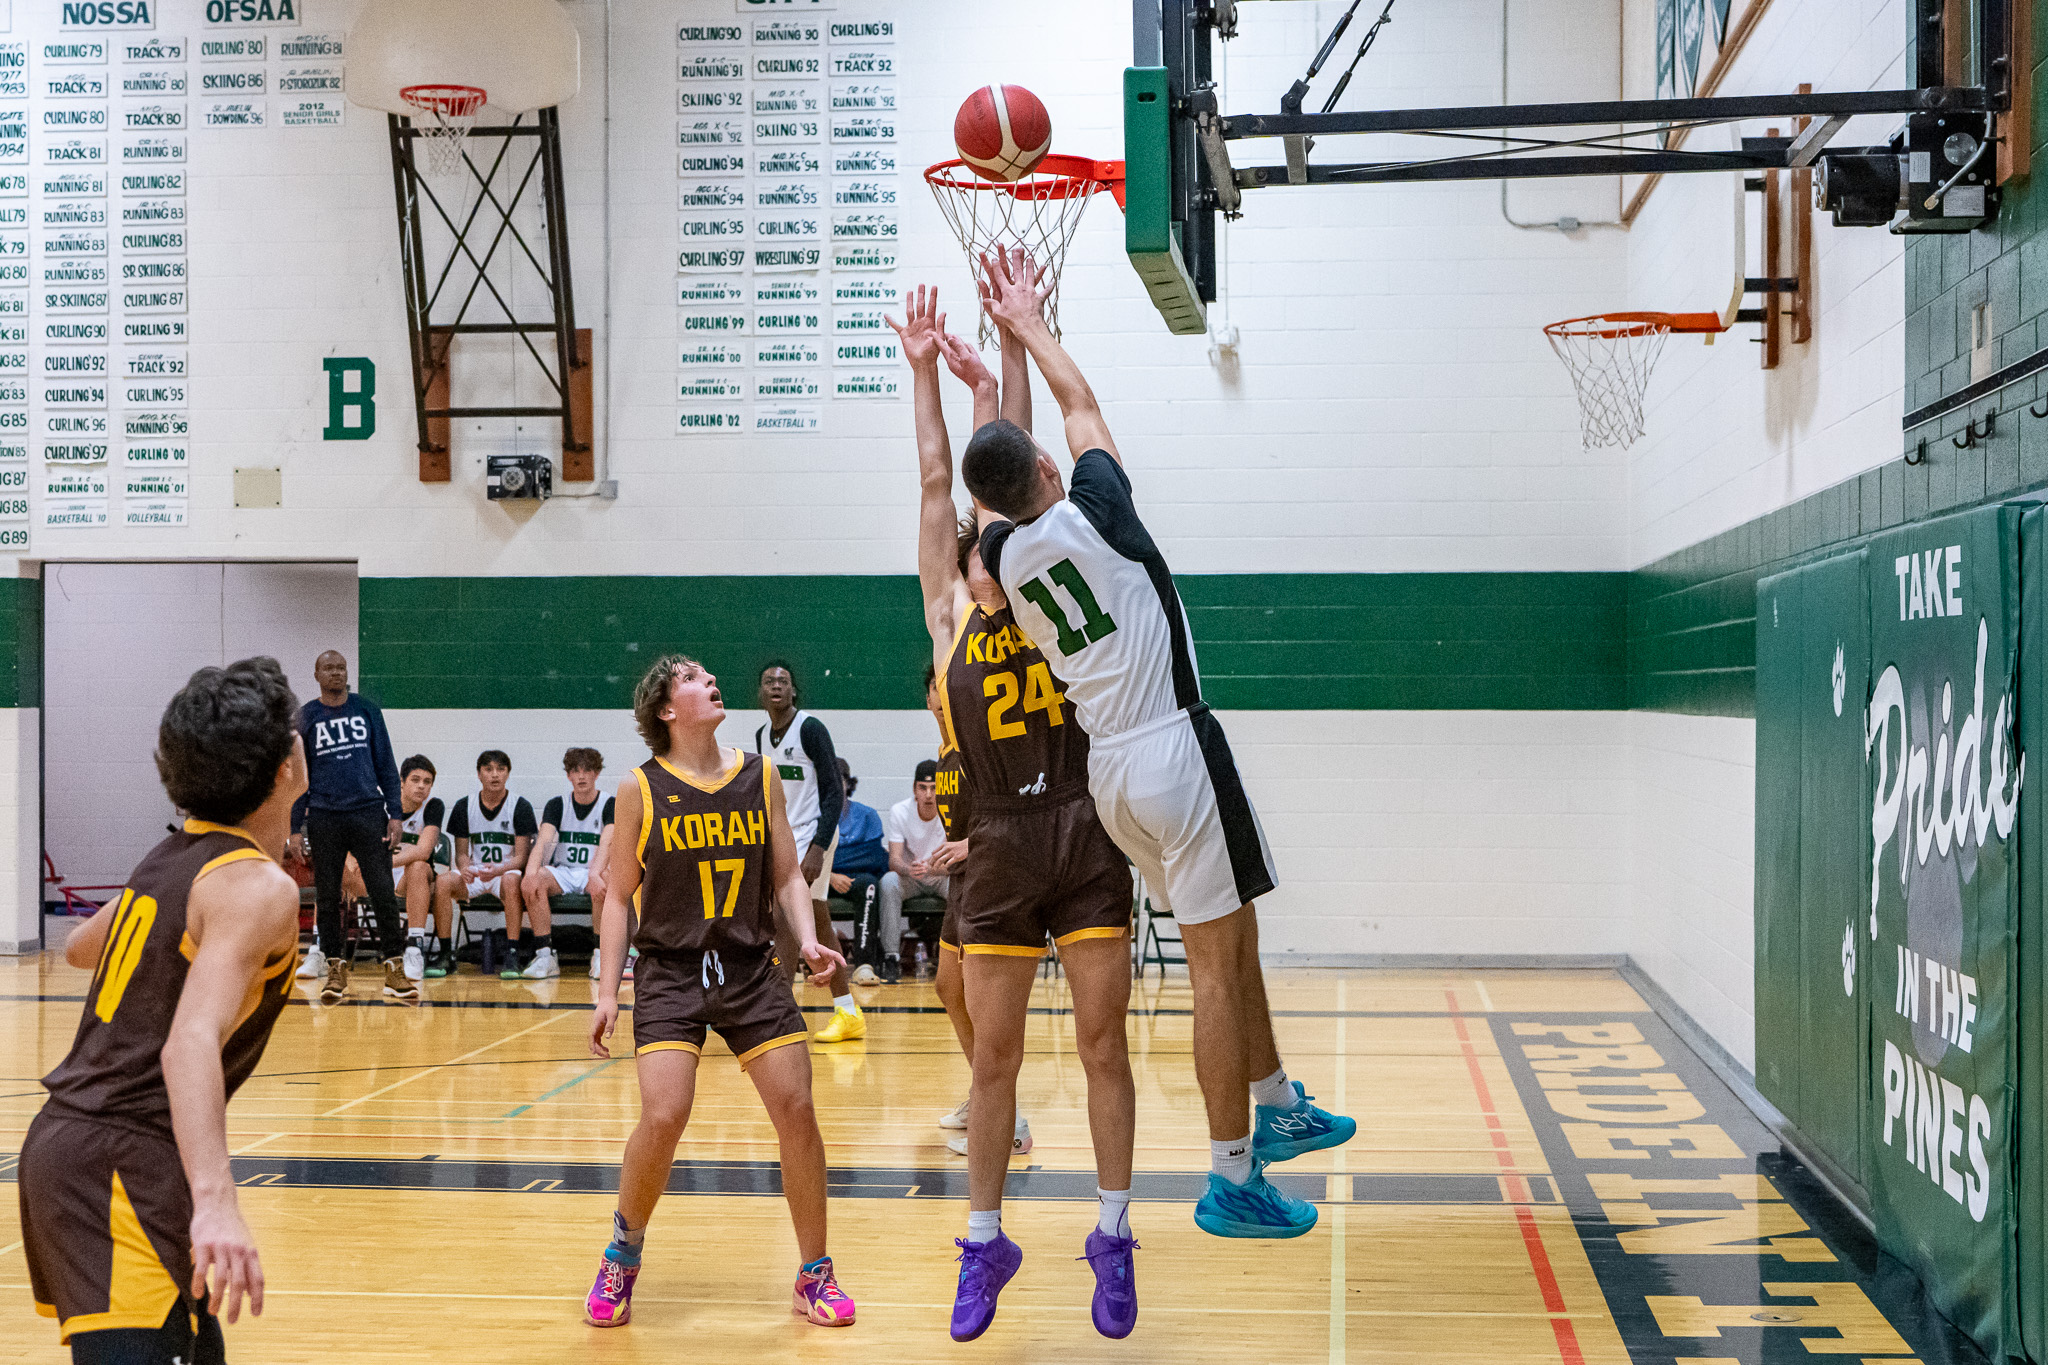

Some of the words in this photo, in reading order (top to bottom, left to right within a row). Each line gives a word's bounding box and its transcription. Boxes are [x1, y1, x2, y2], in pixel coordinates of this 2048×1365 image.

[63, 1, 150, 25] NOSSA
[206, 0, 294, 22] OFSAA
[831, 24, 879, 37] CURLING
[44, 45, 86, 57] CURLING
[202, 41, 245, 55] CURLING
[682, 64, 730, 77] RUNNING
[758, 60, 803, 73] CURLING
[835, 60, 873, 71] TRACK
[203, 75, 244, 88] SKIING
[298, 102, 326, 111] 2012
[682, 94, 723, 106] SKIING
[756, 101, 797, 110] RUNNING
[833, 98, 875, 107] RUNNING
[44, 111, 86, 124] CURLING
[282, 110, 314, 119] SENIOR
[284, 117, 339, 126] BASKETBALL
[757, 124, 796, 137] SKIING
[834, 127, 878, 137] RUNNING
[681, 133, 722, 143] RUNNING
[48, 146, 87, 159] TRACK
[683, 158, 727, 170] CURLING
[836, 158, 878, 171] RUNNING
[759, 190, 801, 204] RUNNING
[836, 190, 878, 203] RUNNING
[683, 221, 728, 235] CURLING
[758, 221, 800, 235] CURLING
[834, 221, 878, 235] RUNNING
[45, 240, 89, 251] RUNNING
[680, 251, 726, 267] CURLING
[756, 251, 803, 265] WRESTLING
[836, 257, 879, 265] RUNNING
[124, 293, 168, 307] CURLING
[682, 290, 726, 299] RUNNING
[758, 290, 801, 299] RUNNING
[837, 290, 880, 298] RUNNING
[685, 317, 729, 329] CURLING
[758, 316, 800, 327] CURLING
[837, 320, 879, 329] RUNNING
[125, 324, 169, 336] CURLING
[683, 354, 724, 362] RUNNING
[759, 352, 801, 361] RUNNING
[838, 346, 880, 358] CURLING
[45, 356, 90, 371] CURLING
[129, 360, 165, 373] TRACK
[682, 386, 724, 395] RUNNING
[759, 385, 801, 394] RUNNING
[838, 384, 881, 392] RUNNING
[45, 389, 89, 402] CURLING
[127, 389, 168, 401] CURLING
[323, 357, 375, 440] B
[48, 418, 89, 431] CURLING
[681, 414, 722, 426] CURLING
[756, 418, 805, 428] BASKETBALL
[126, 422, 170, 433] RUNNING
[45, 446, 89, 459] CURLING
[128, 448, 168, 460] CURLING
[49, 484, 88, 492] RUNNING
[128, 484, 170, 493] RUNNING
[47, 514, 92, 524] BASKETBALL
[128, 513, 170, 522] VOLLEYBALL
[1894, 545, 1962, 622] TAKE
[1018, 557, 1118, 657] 11
[965, 623, 1038, 665] KORA
[982, 661, 1065, 741] 24
[315, 716, 367, 749] ATS
[1863, 615, 2025, 940] Pride
[660, 810, 765, 852] KORAH
[480, 846, 502, 863] 20
[567, 847, 589, 864] 30
[698, 858, 745, 919] 17
[859, 884, 875, 948] Champion
[1895, 944, 1920, 1023] IN
[1925, 957, 1977, 1053] THE
[1509, 1022, 1746, 1159] PRIDE
[1882, 1038, 1991, 1222] PINES
[1585, 1173, 1838, 1262] IN
